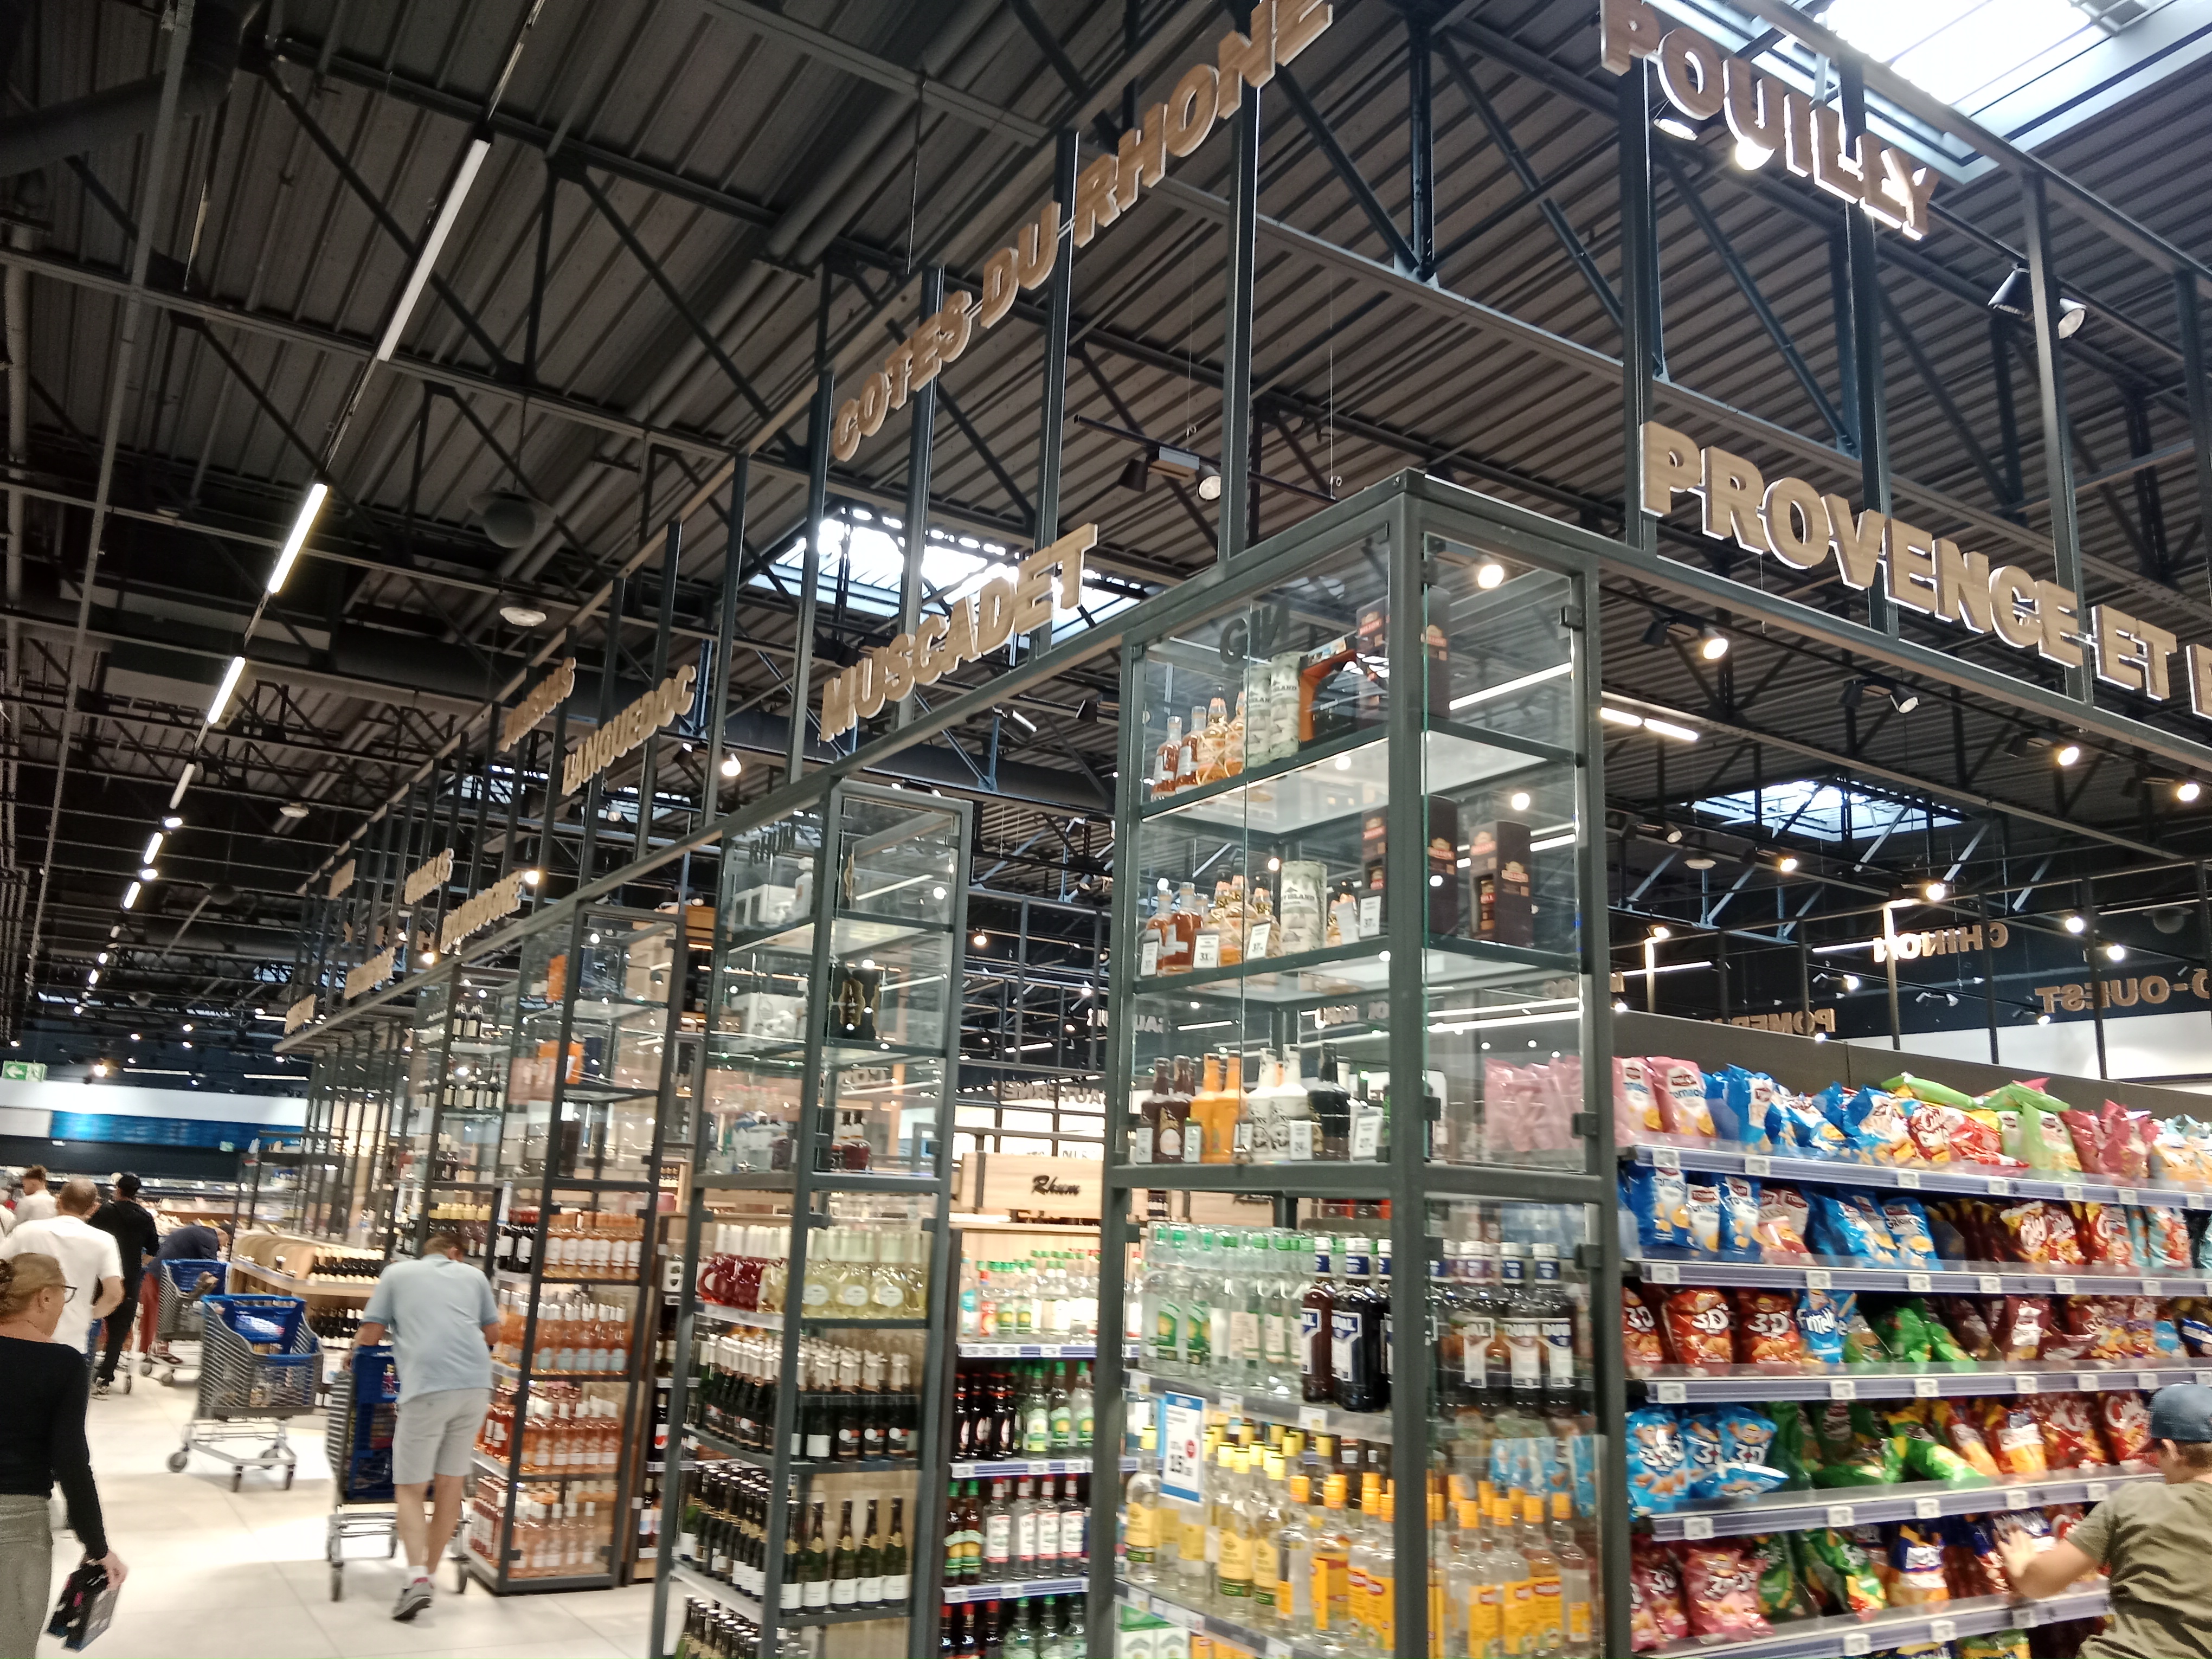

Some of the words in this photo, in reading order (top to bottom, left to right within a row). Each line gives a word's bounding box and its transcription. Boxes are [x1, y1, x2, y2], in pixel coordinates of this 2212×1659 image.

[1600, 0, 1940, 241] POUILLY
[980, 201, 1062, 329] DU
[820, 523, 1099, 742] MUSCADET
[1639, 420, 2083, 669] PROVENCE
[2091, 605, 2177, 702] ET
[562, 664, 697, 796] LANGUEDOC
[1747, 1313, 1789, 1331] 3D
